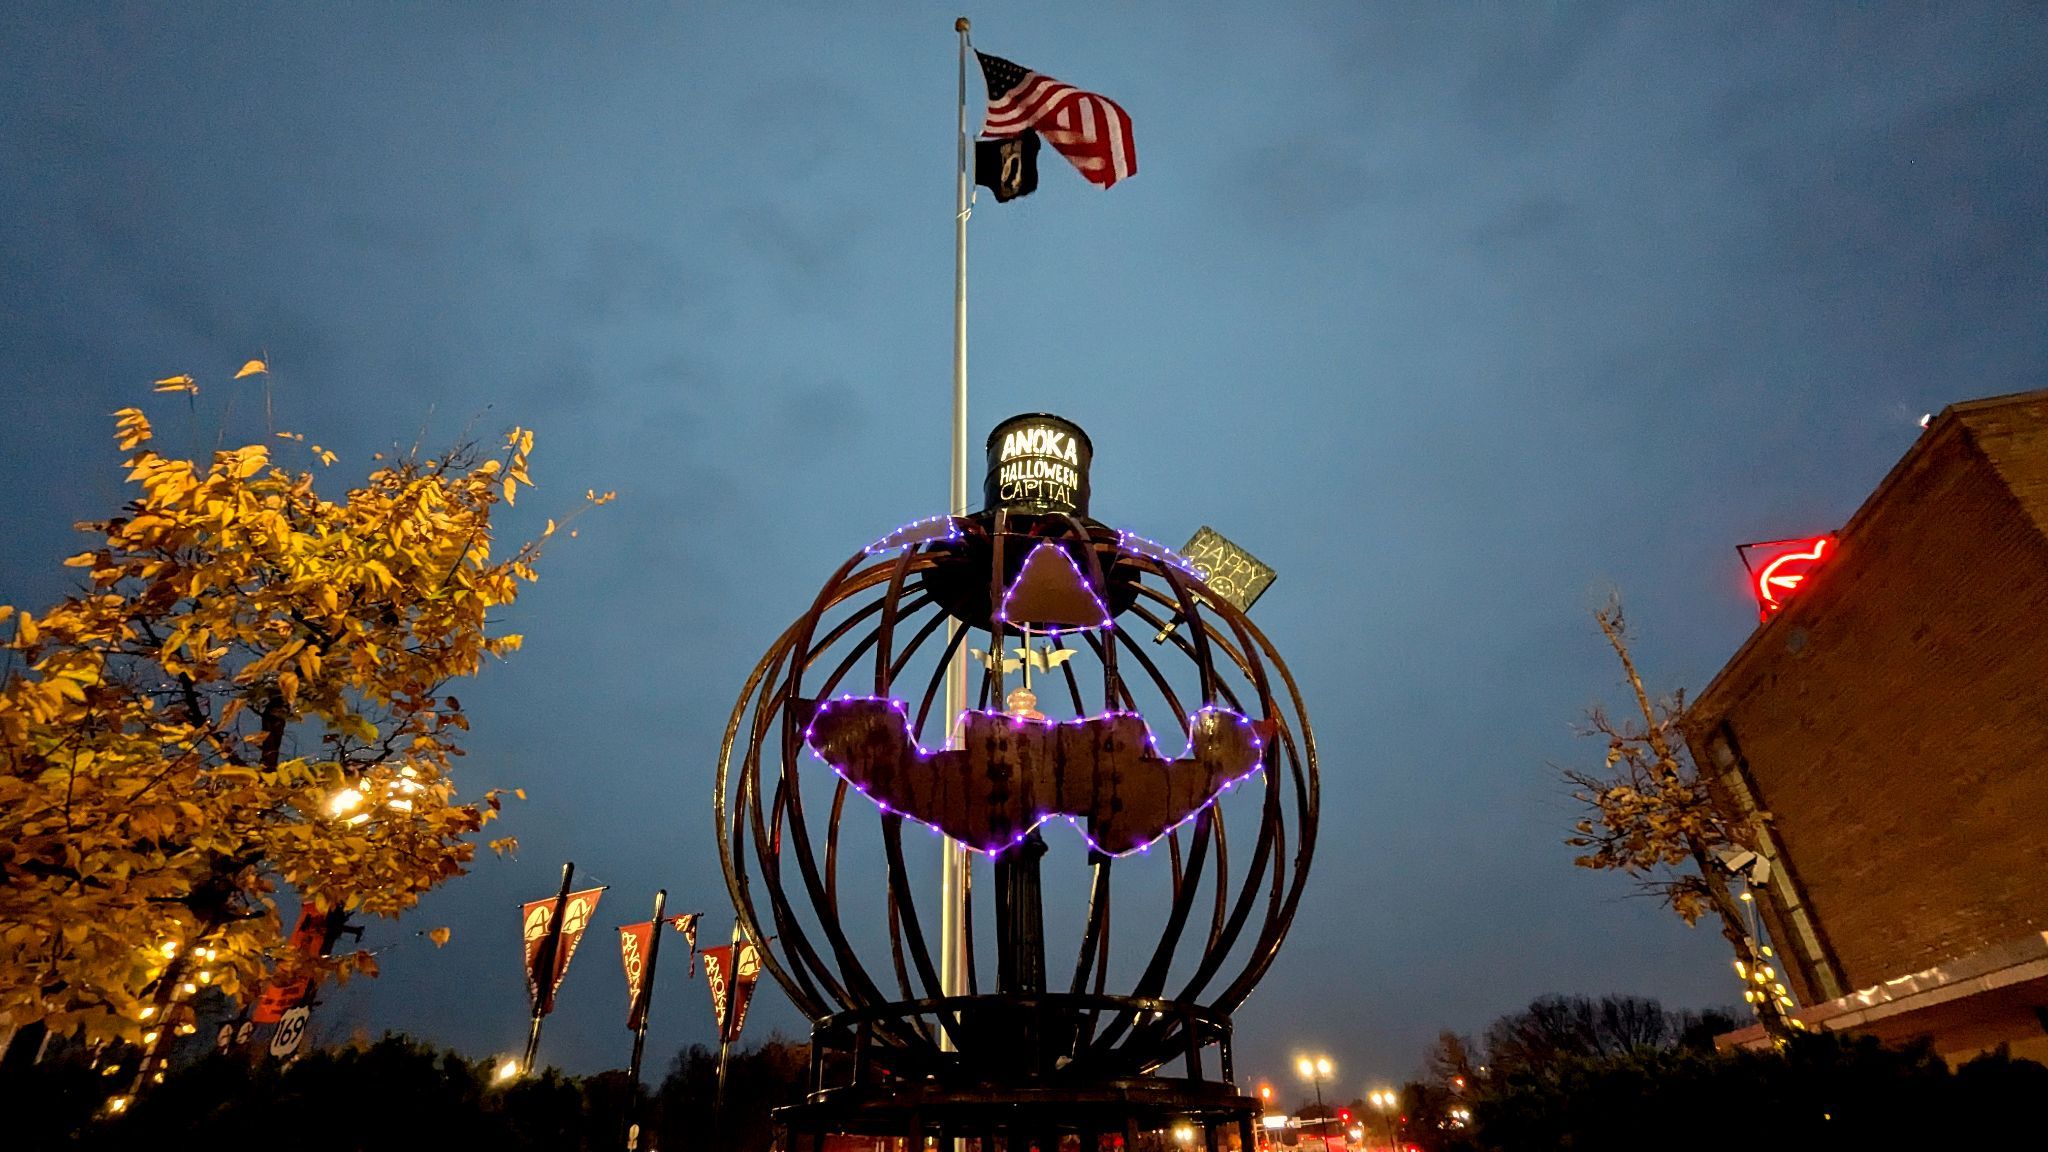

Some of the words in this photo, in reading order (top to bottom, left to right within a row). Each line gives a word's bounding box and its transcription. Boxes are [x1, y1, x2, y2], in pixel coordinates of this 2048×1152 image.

[1001, 428, 1077, 466] ANOKA
[1000, 458, 1078, 490] HALLOWEEN
[1000, 479, 1077, 509] CAPITAL
[1195, 535, 1267, 588] HAPPY
[274, 1016, 305, 1047] 169
